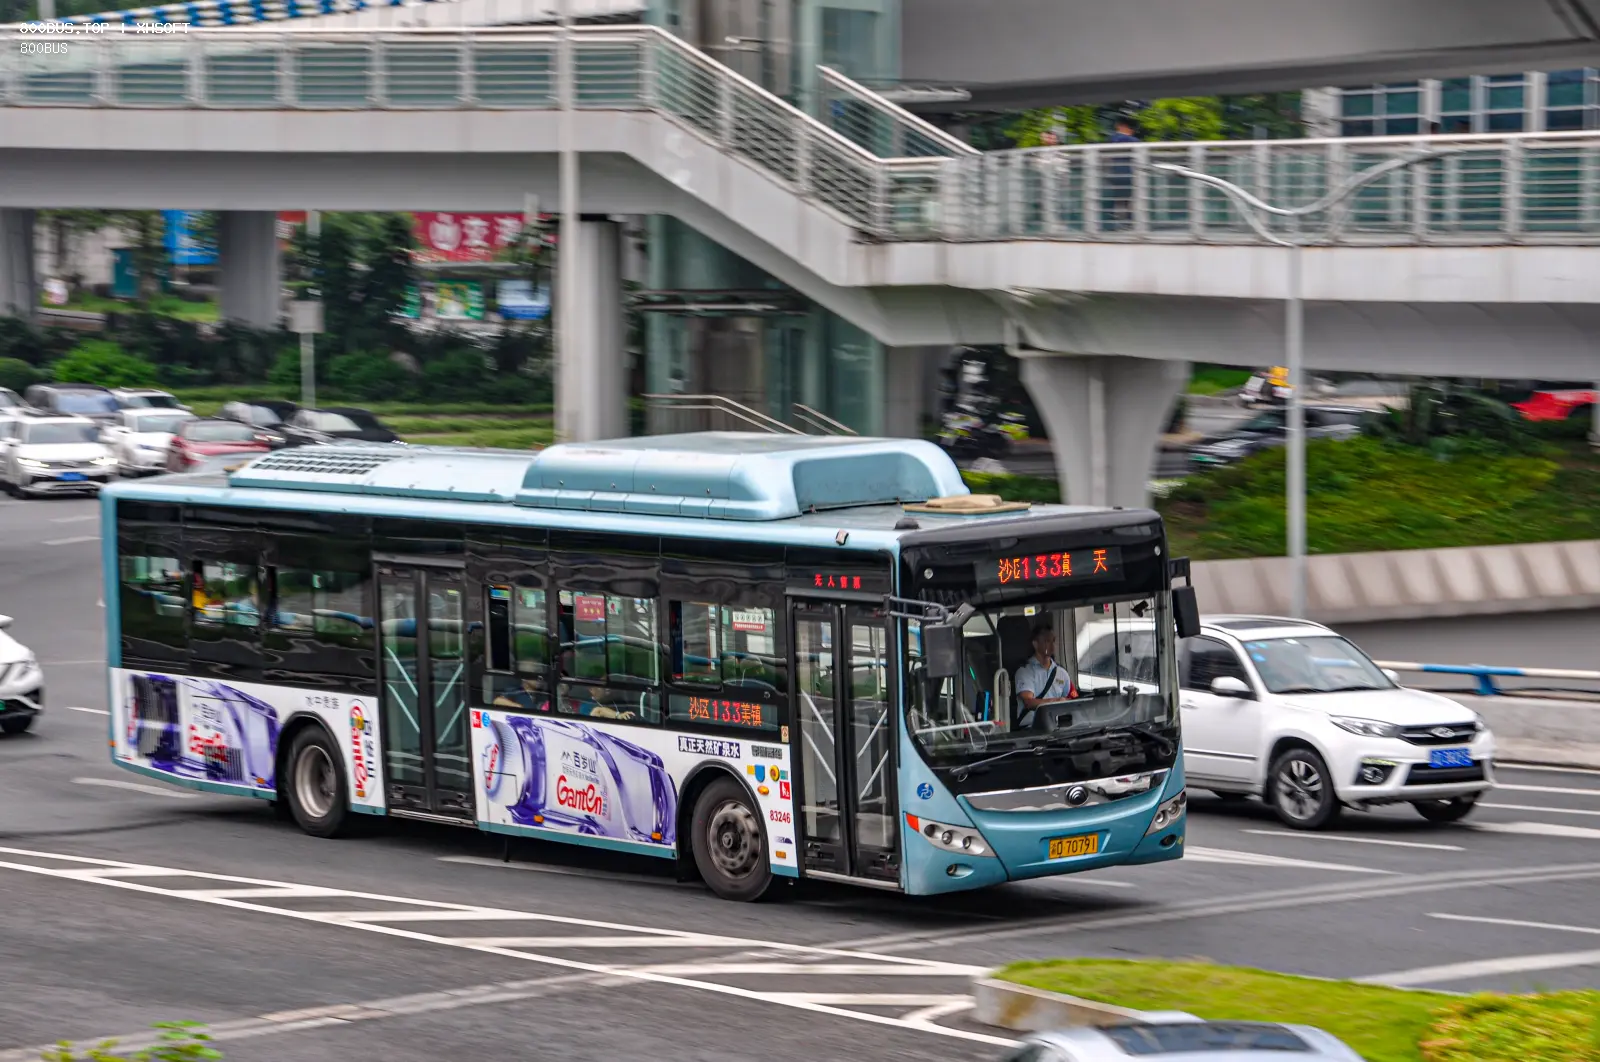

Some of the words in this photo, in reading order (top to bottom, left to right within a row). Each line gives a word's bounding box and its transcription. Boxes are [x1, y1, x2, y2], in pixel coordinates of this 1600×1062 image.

[679, 736, 740, 759] 真正天然矿泉水
[556, 774, 603, 816] Ganten
[769, 809, 791, 824] 83246
